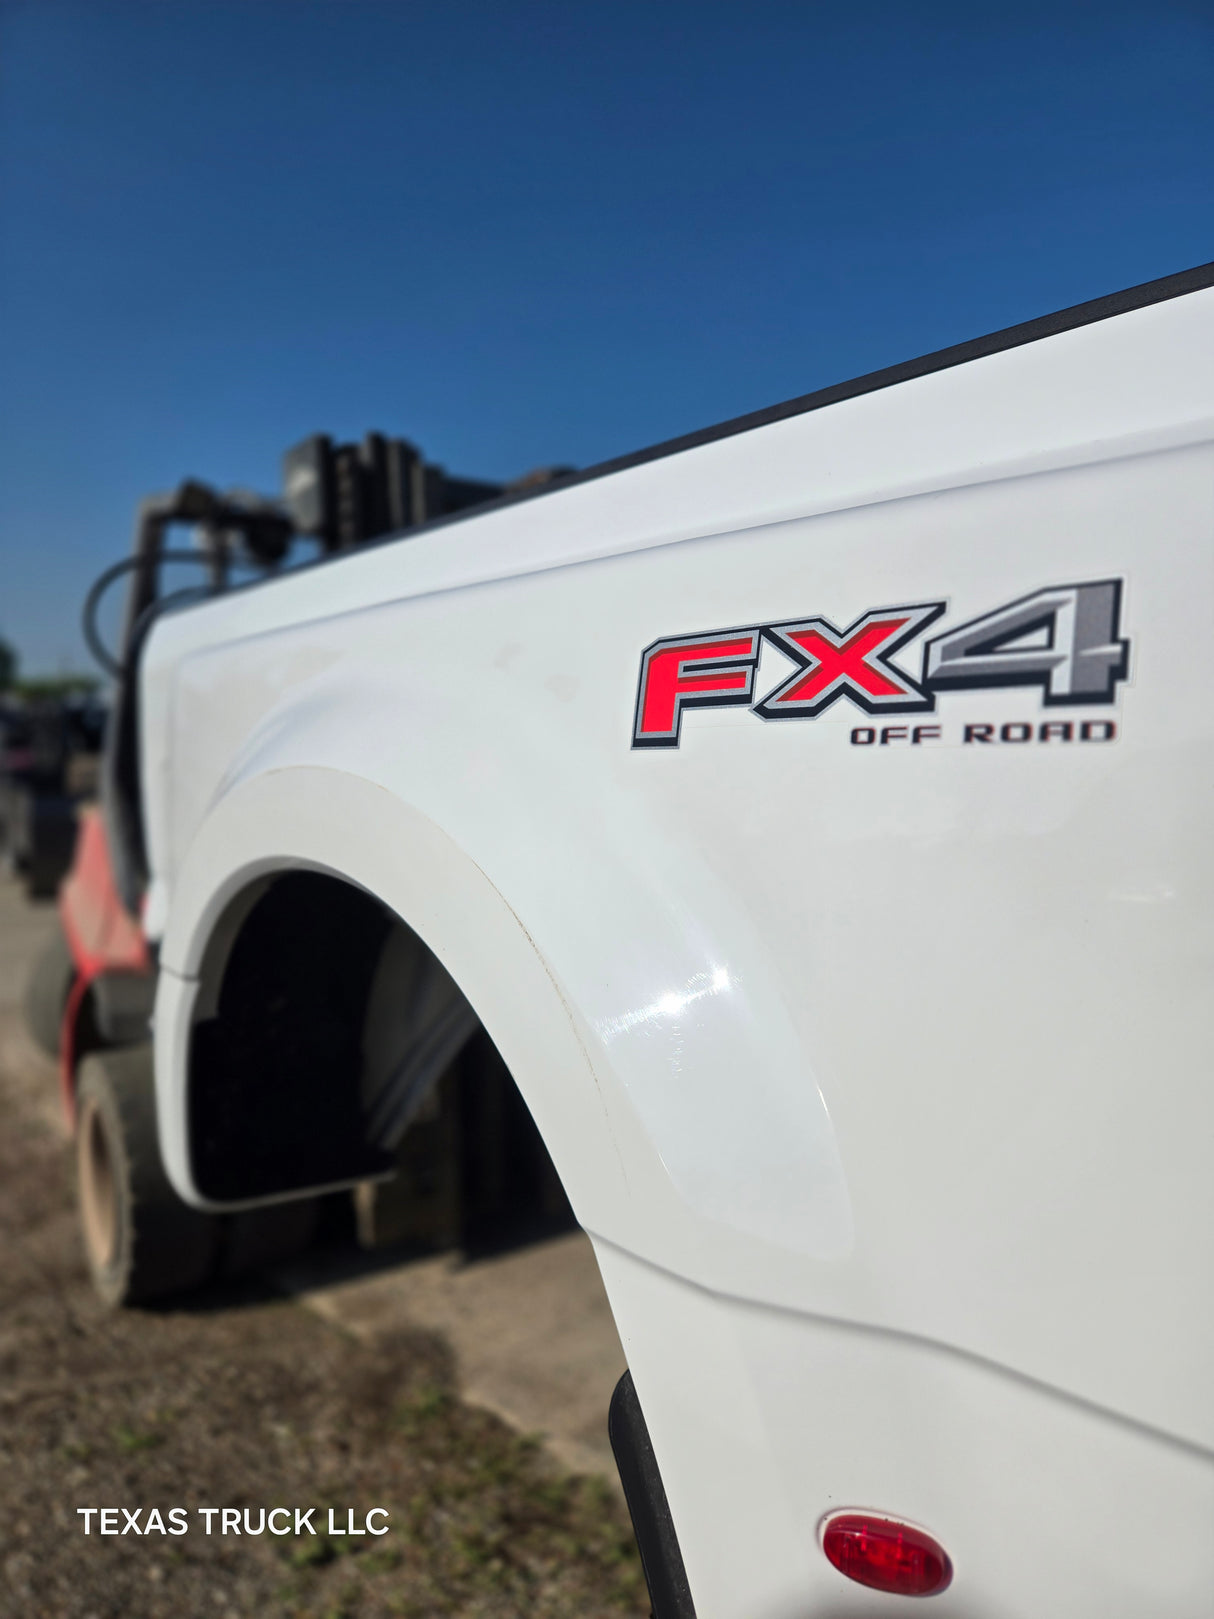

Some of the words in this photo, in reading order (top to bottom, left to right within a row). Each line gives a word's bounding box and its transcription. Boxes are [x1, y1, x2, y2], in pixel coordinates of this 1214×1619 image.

[631, 578, 1130, 749] FX4
[850, 725, 942, 745] OFF
[963, 720, 1116, 743] ROAD
